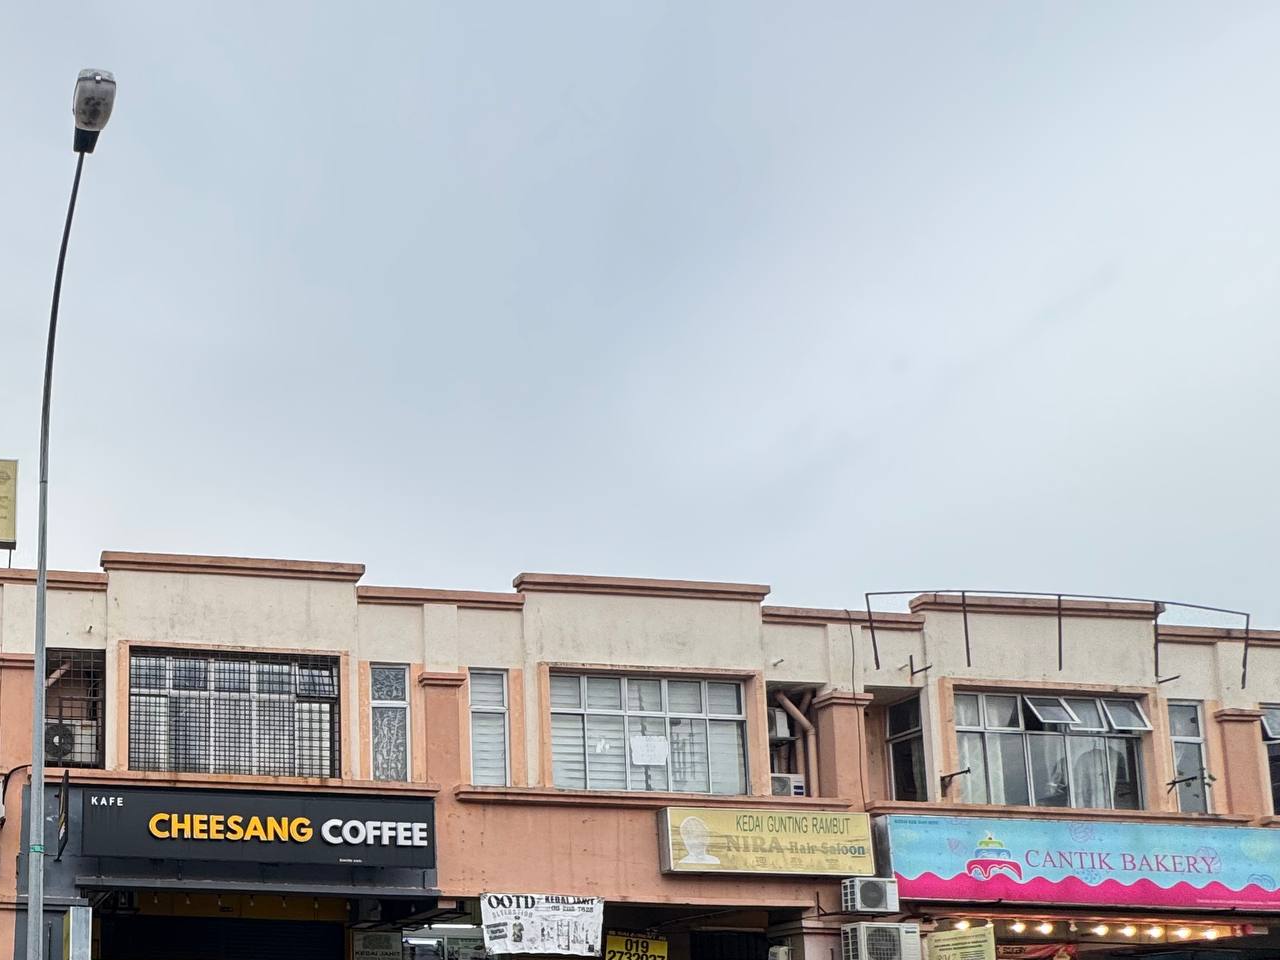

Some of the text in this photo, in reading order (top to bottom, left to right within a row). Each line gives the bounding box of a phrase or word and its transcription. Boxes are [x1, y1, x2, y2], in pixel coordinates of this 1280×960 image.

[91, 796, 124, 806] KAFE
[148, 812, 428, 847] CHEESANG COFFEE
[736, 815, 850, 835] KEDAI GUNTING RAMBUT
[726, 834, 866, 855] NIRA Hair Saloon
[1024, 848, 1218, 875] CANTIK BAKERY
[488, 895, 536, 909] OOTD
[625, 939, 649, 953] 019
